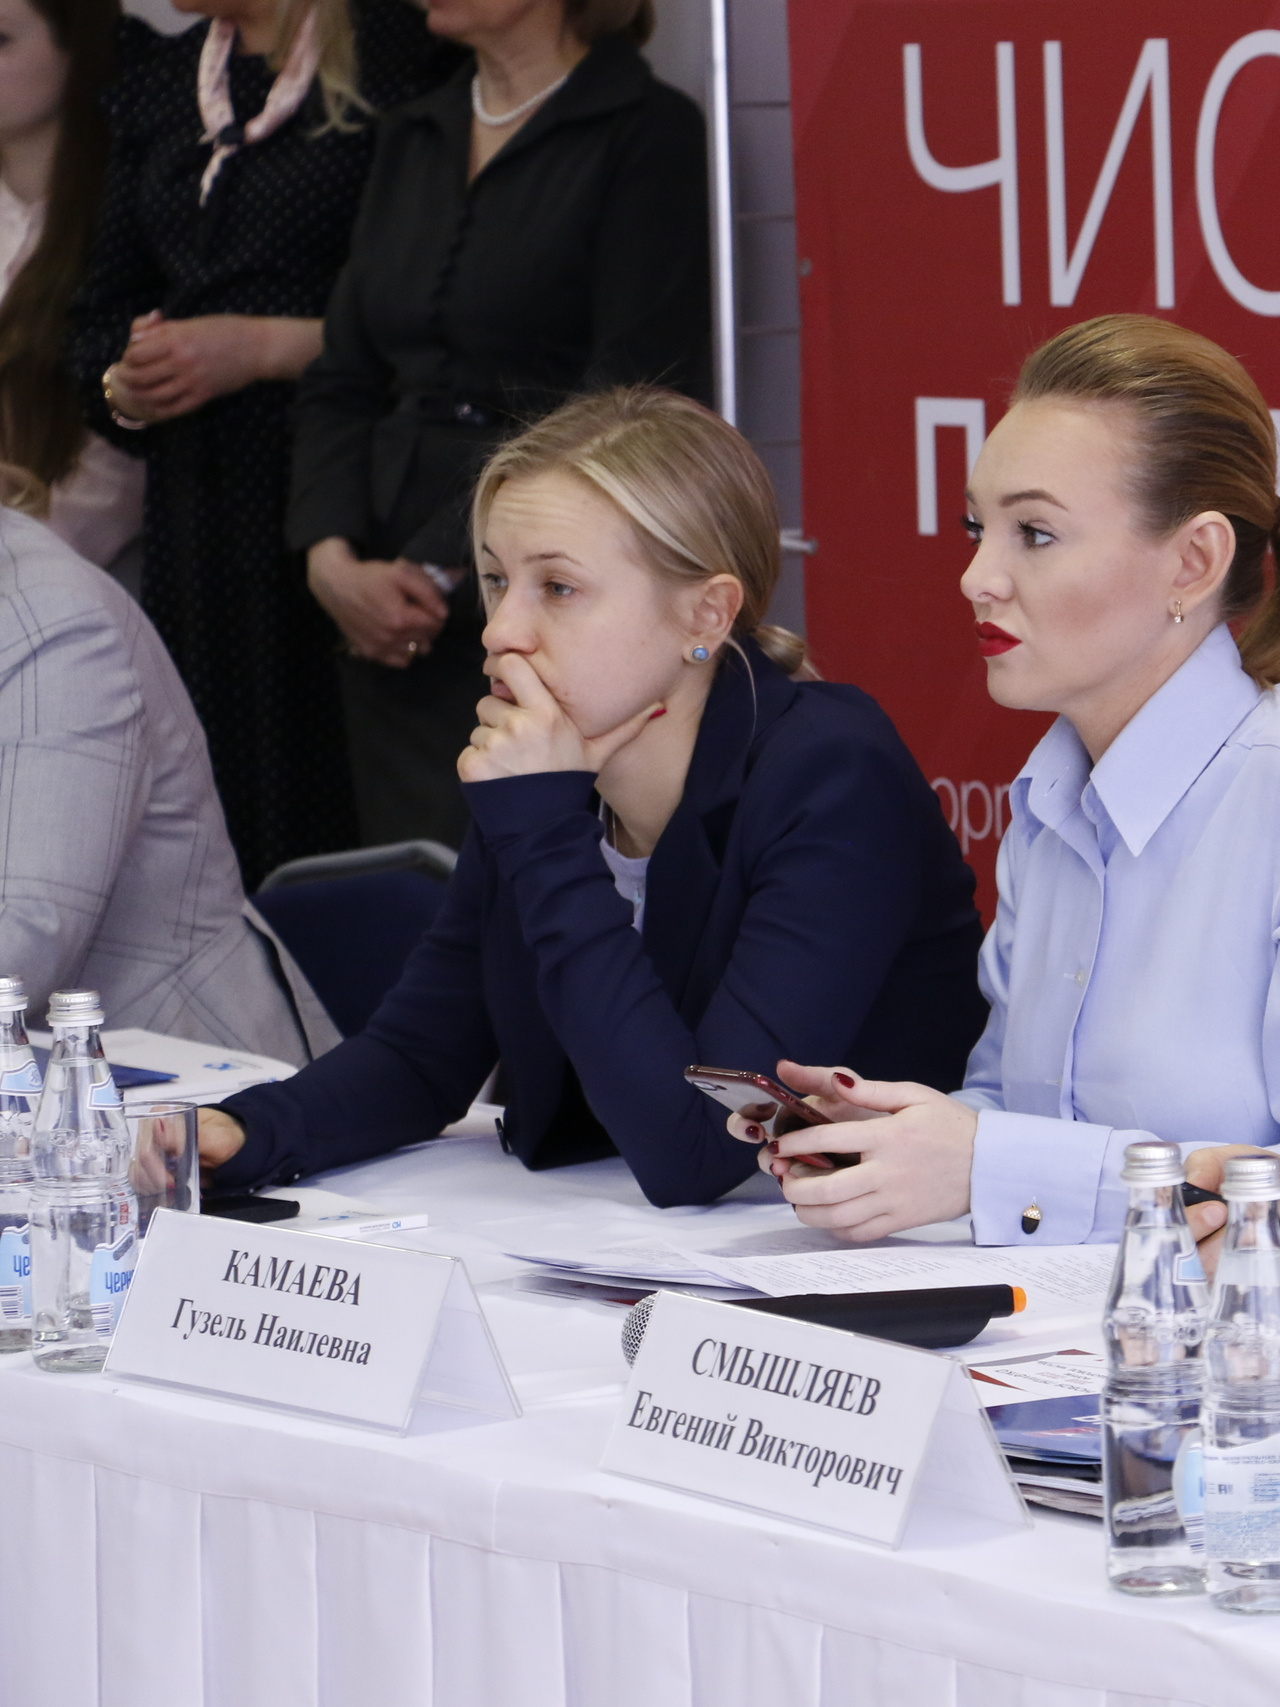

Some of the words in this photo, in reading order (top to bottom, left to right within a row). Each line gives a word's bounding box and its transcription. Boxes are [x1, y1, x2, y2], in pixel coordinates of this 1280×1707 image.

[221, 1249, 361, 1307] КАМАЕВА
[170, 1297, 247, 1341] Гузель
[252, 1312, 372, 1366] Наилевна
[691, 1337, 882, 1417] СМЫШЛЯЕВ
[627, 1389, 738, 1452] Евгений
[736, 1417, 904, 1496] Викторович
